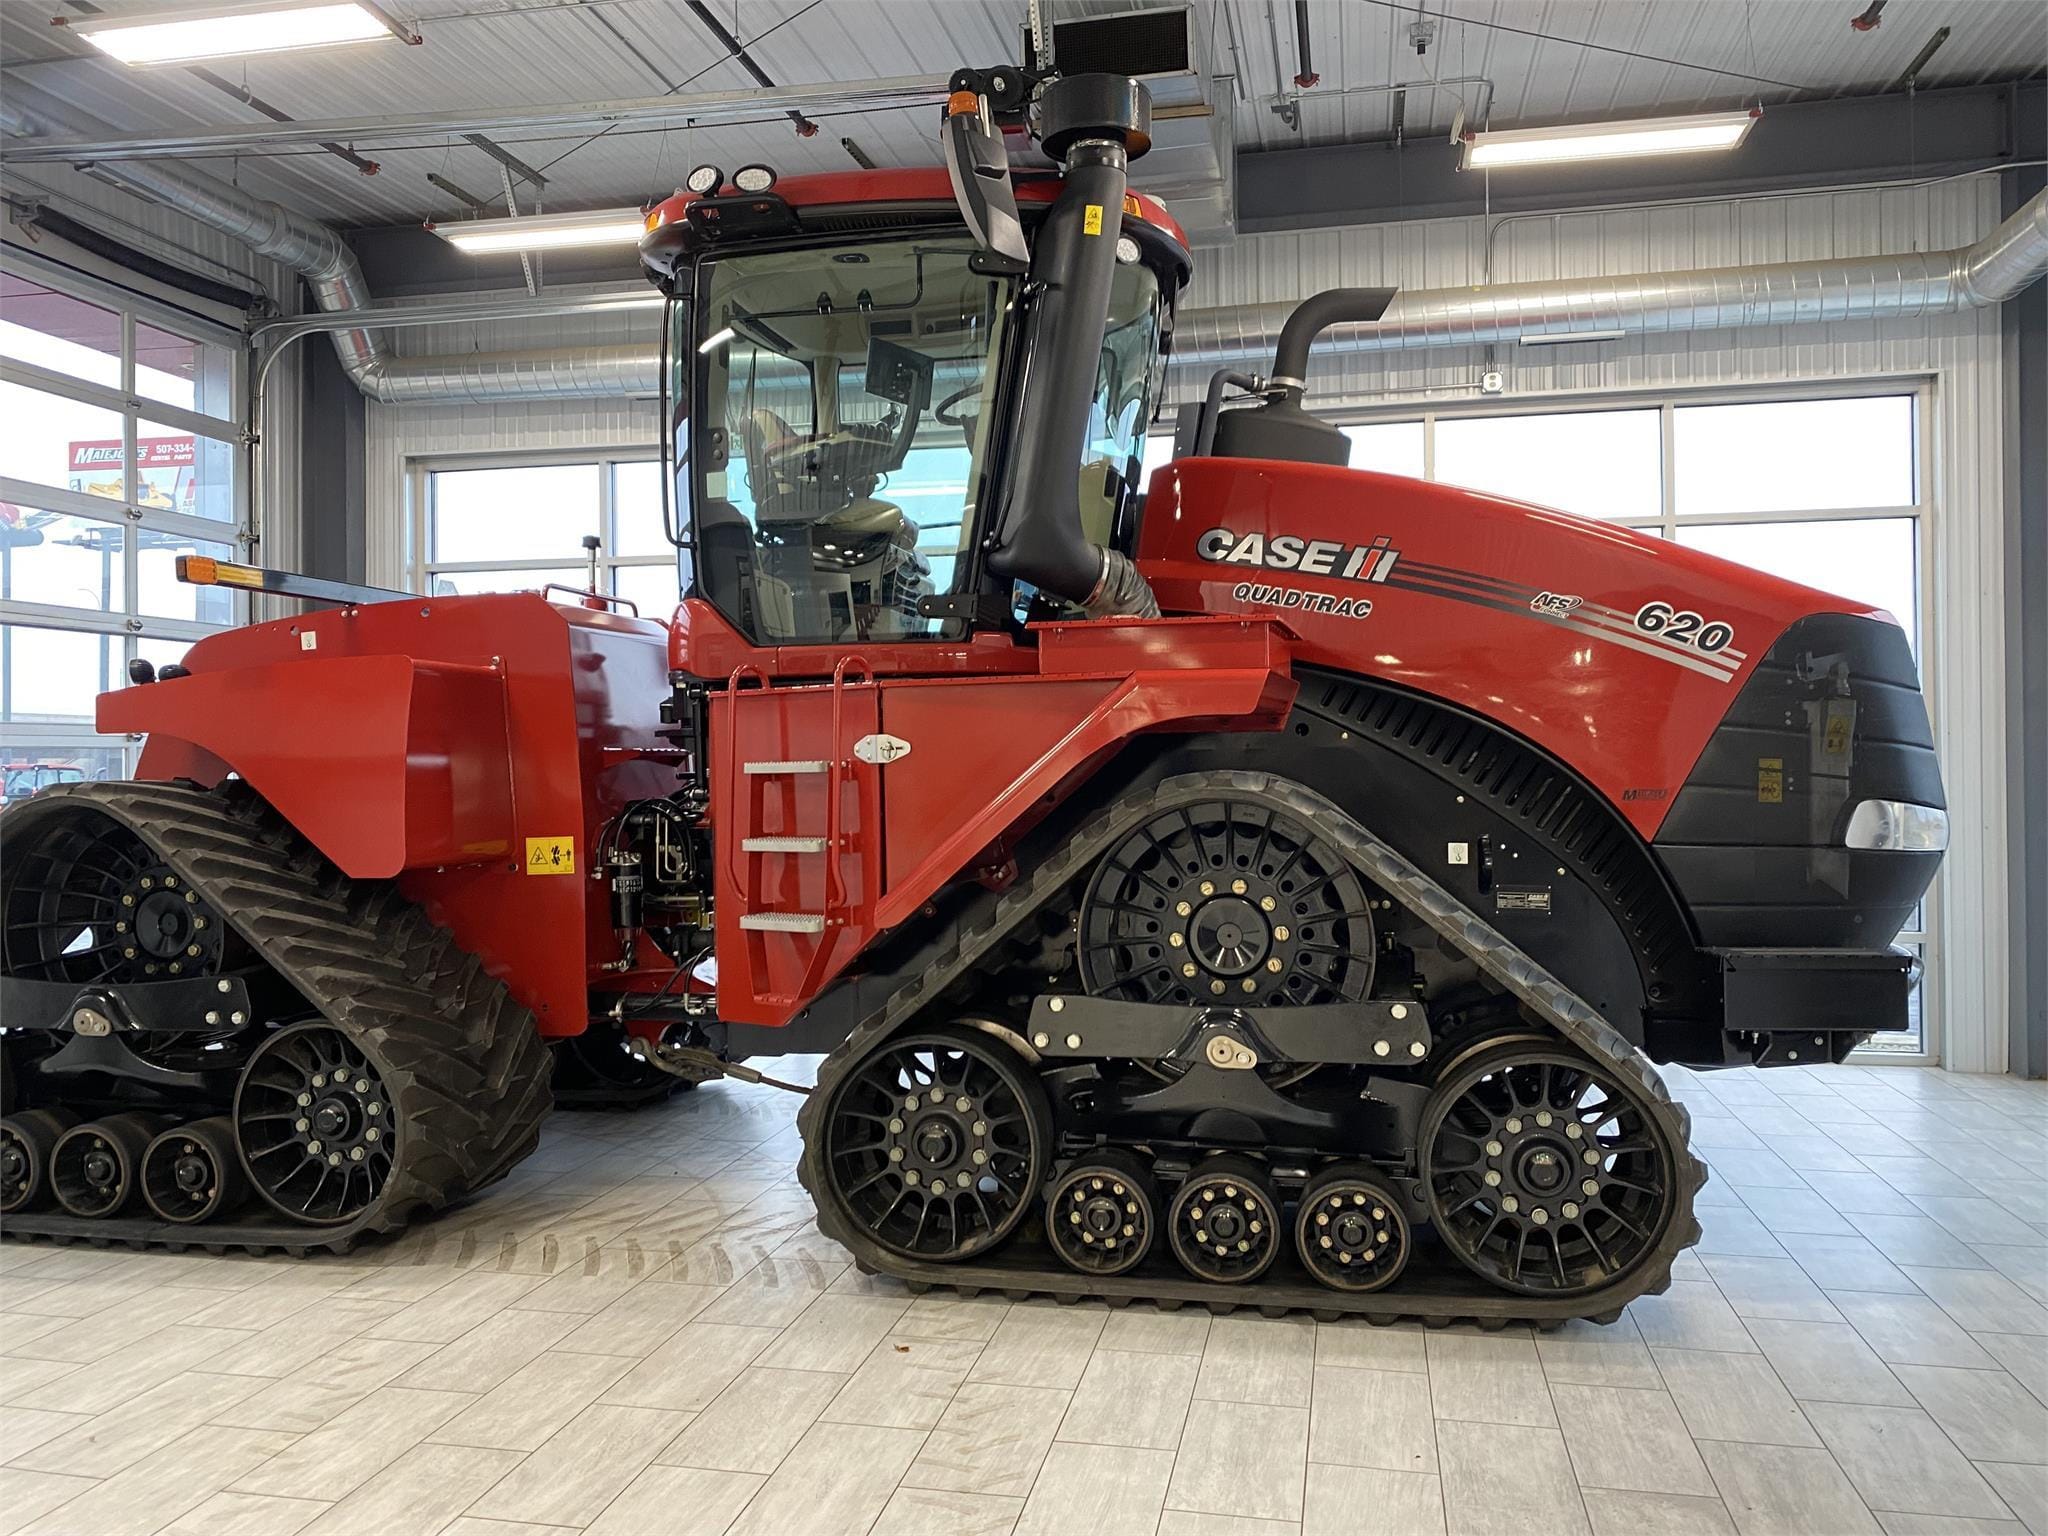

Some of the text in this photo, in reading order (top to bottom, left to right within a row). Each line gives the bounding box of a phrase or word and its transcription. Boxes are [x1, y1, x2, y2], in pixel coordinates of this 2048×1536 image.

[156, 443, 195, 454] 507-334-
[1196, 527, 1345, 576] CASE
[1233, 582, 1373, 618] QUADTRAC
[1530, 591, 1573, 610] AFS
[1634, 601, 1734, 654] 620
